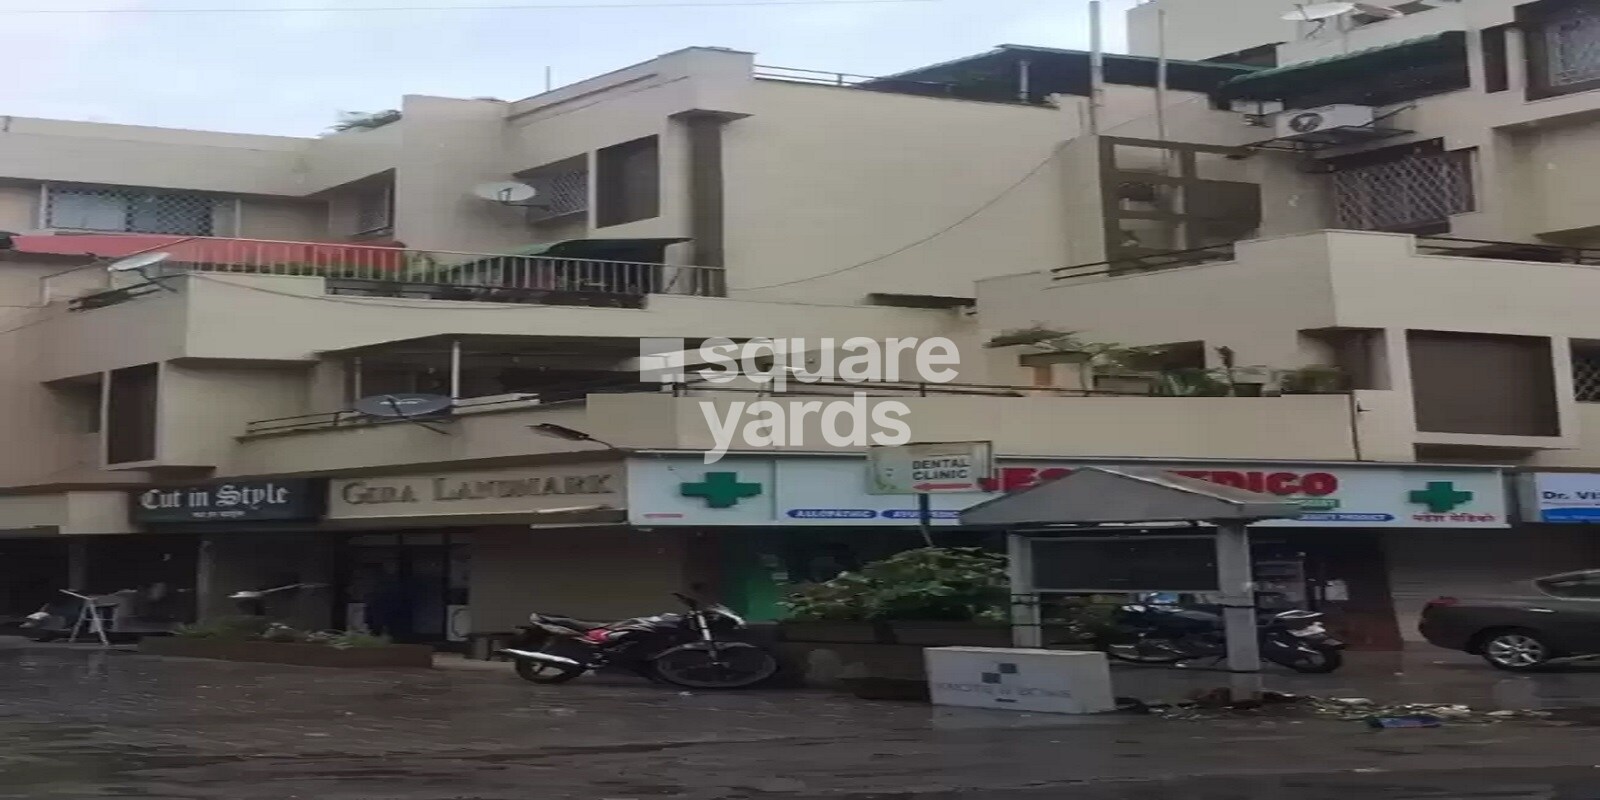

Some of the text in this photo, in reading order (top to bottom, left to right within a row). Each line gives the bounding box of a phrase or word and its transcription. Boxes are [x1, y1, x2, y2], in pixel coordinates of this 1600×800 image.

[912, 459, 972, 470] DENTAL
[912, 469, 968, 481] CLINIC
[432, 474, 615, 501] LANDMARK
[141, 483, 290, 510] Cut in Style
[1543, 490, 1569, 500] Dr.
